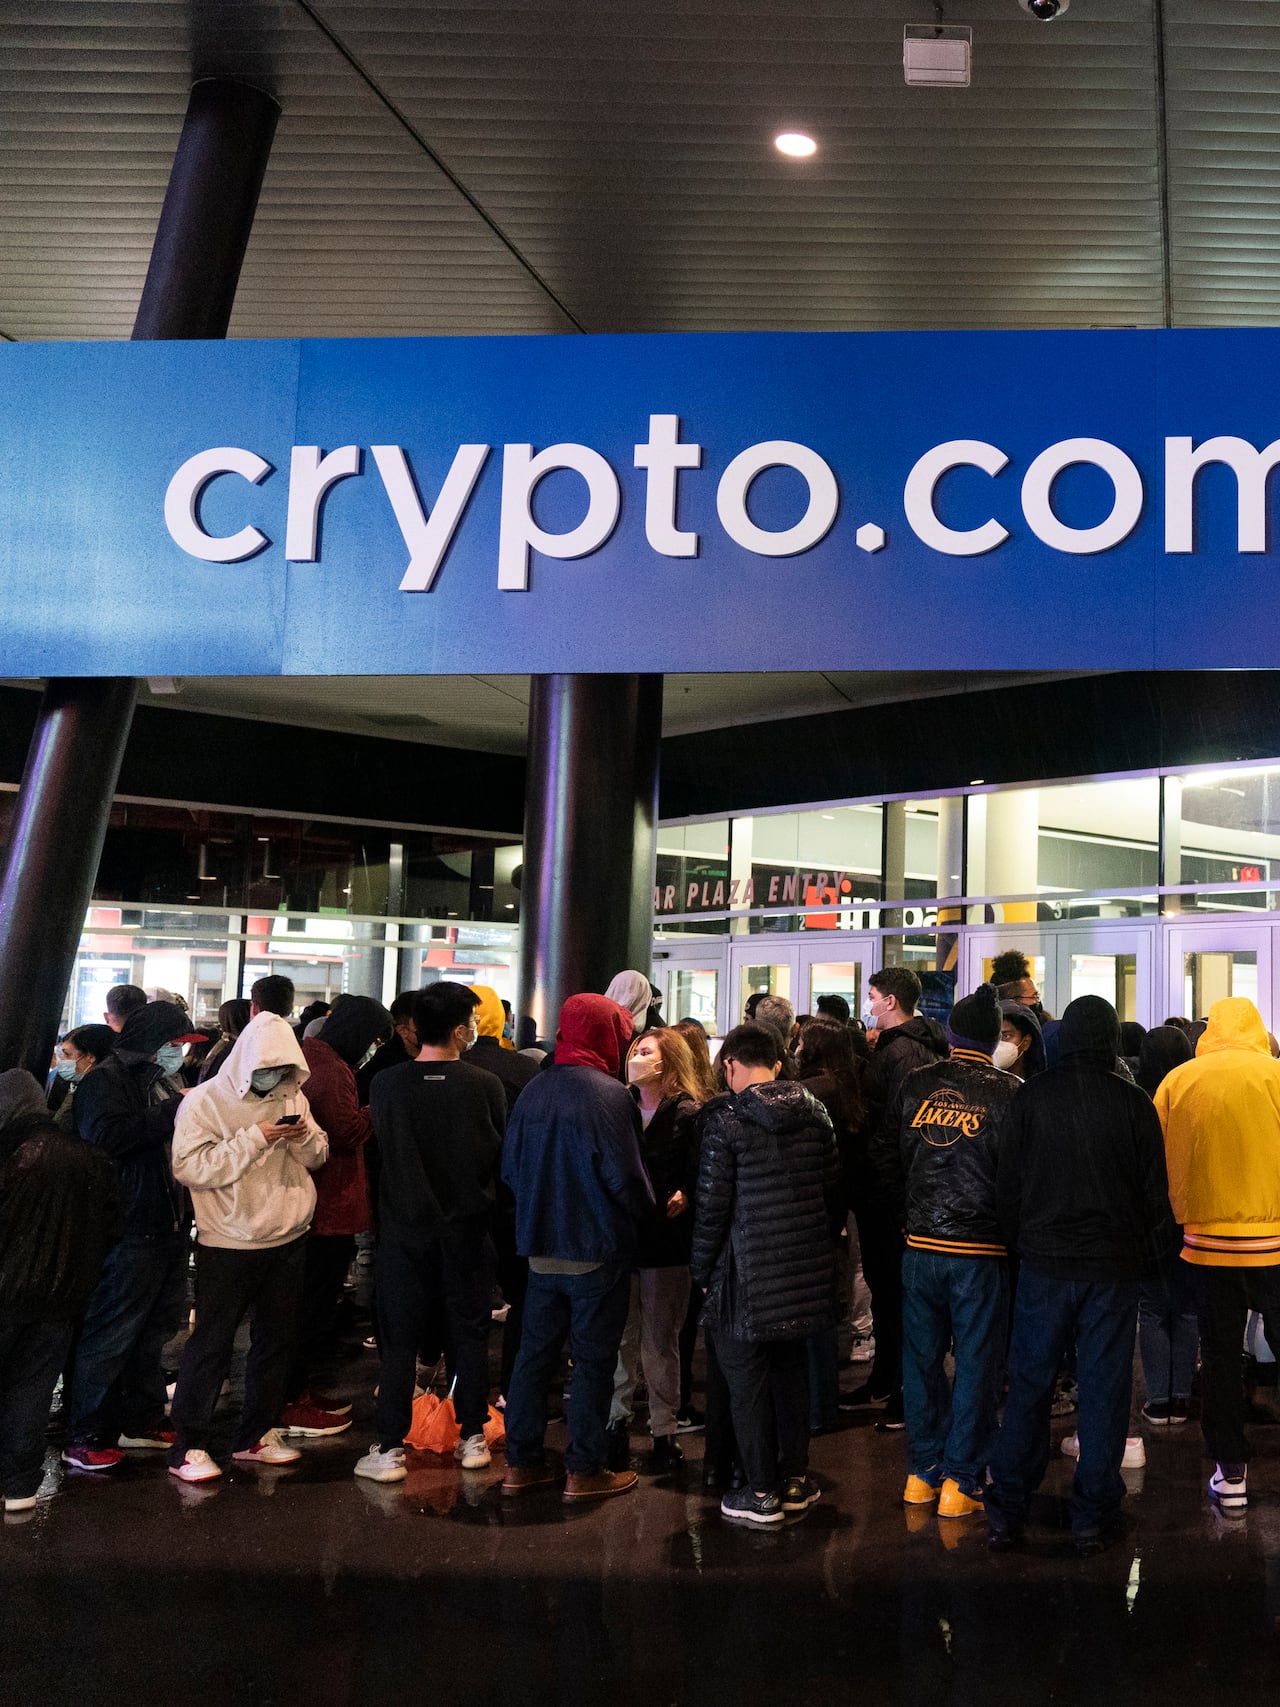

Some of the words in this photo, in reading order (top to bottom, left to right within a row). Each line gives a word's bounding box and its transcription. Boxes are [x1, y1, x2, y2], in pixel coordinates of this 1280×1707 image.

[686, 878, 755, 908] PLAZA
[768, 871, 848, 903] ENTRY
[1054, 901, 1063, 919] 3
[798, 914, 807, 931] 2
[933, 1100, 948, 1108] LOS
